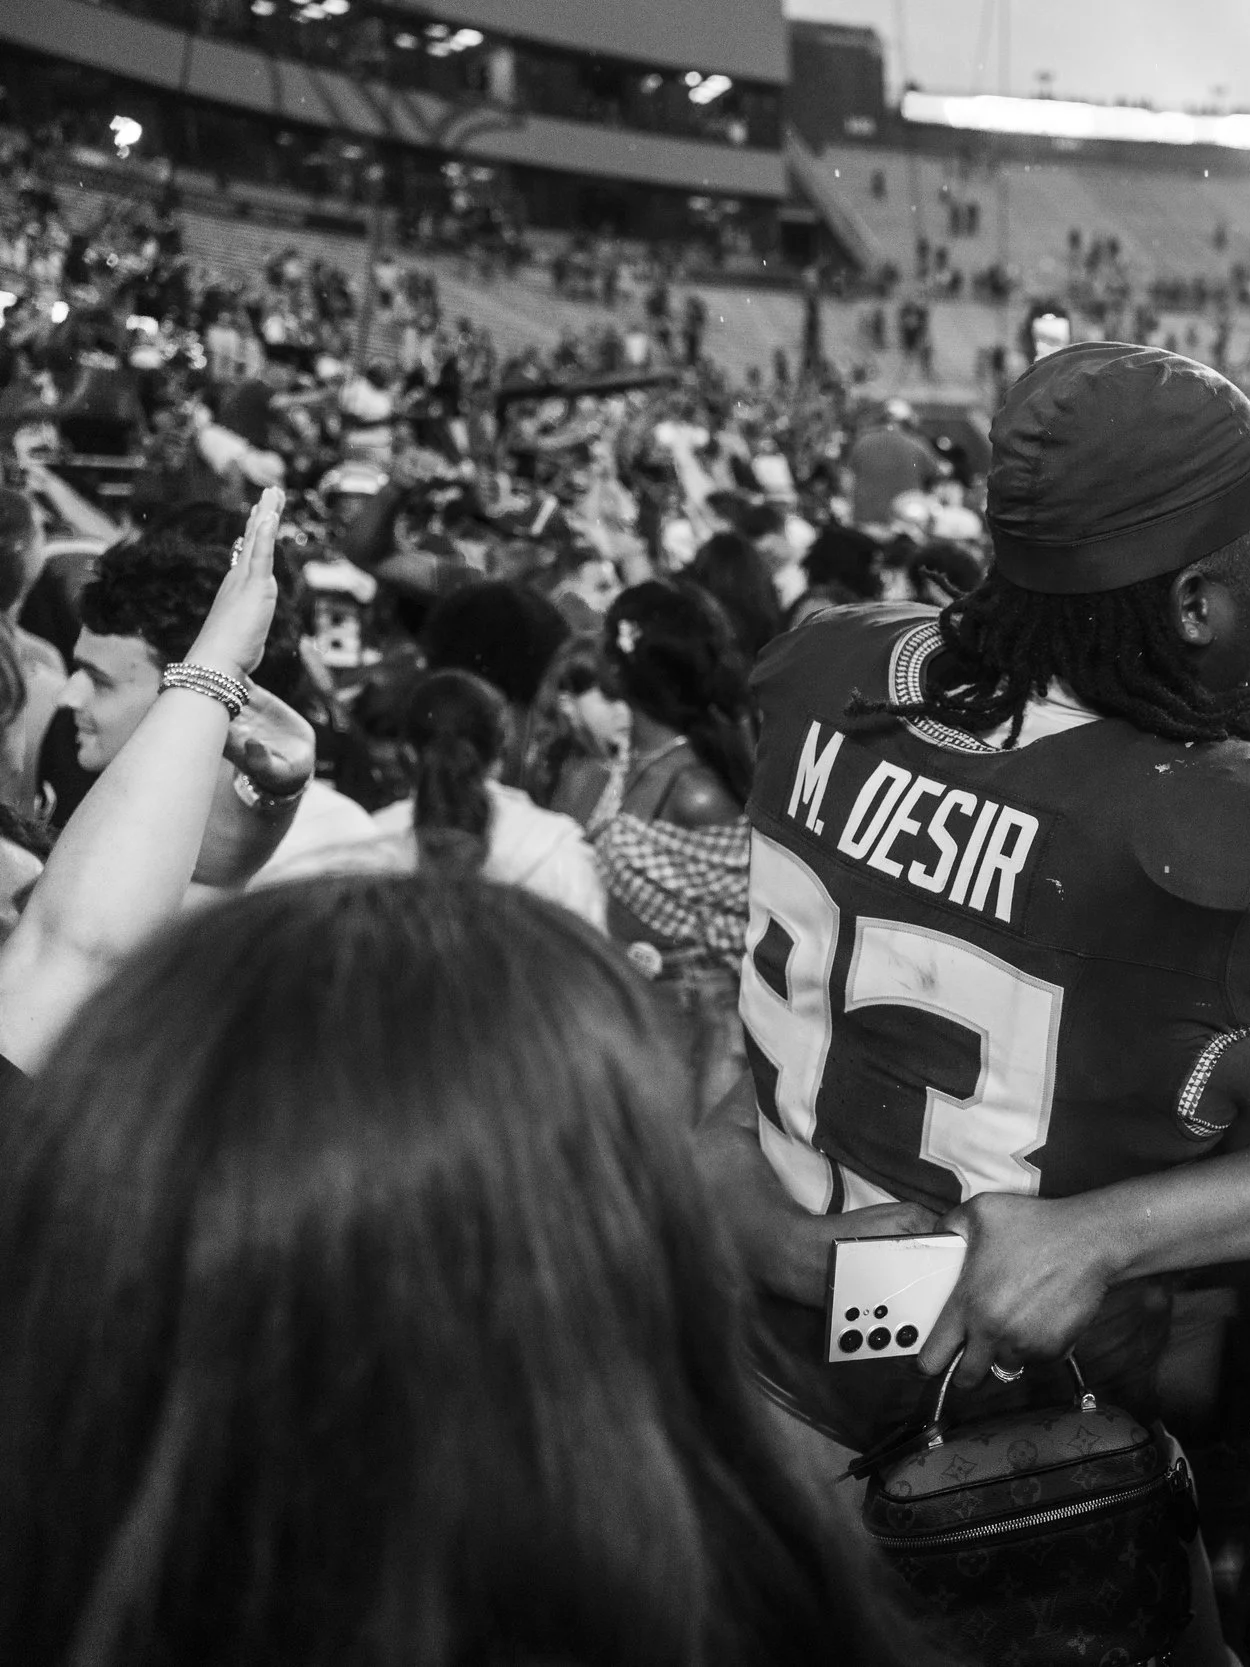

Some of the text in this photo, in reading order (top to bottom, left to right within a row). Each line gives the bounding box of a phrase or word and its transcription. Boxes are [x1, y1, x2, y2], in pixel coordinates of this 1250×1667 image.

[787, 720, 1039, 924] M. DESIR
[738, 826, 1064, 1216] 93
